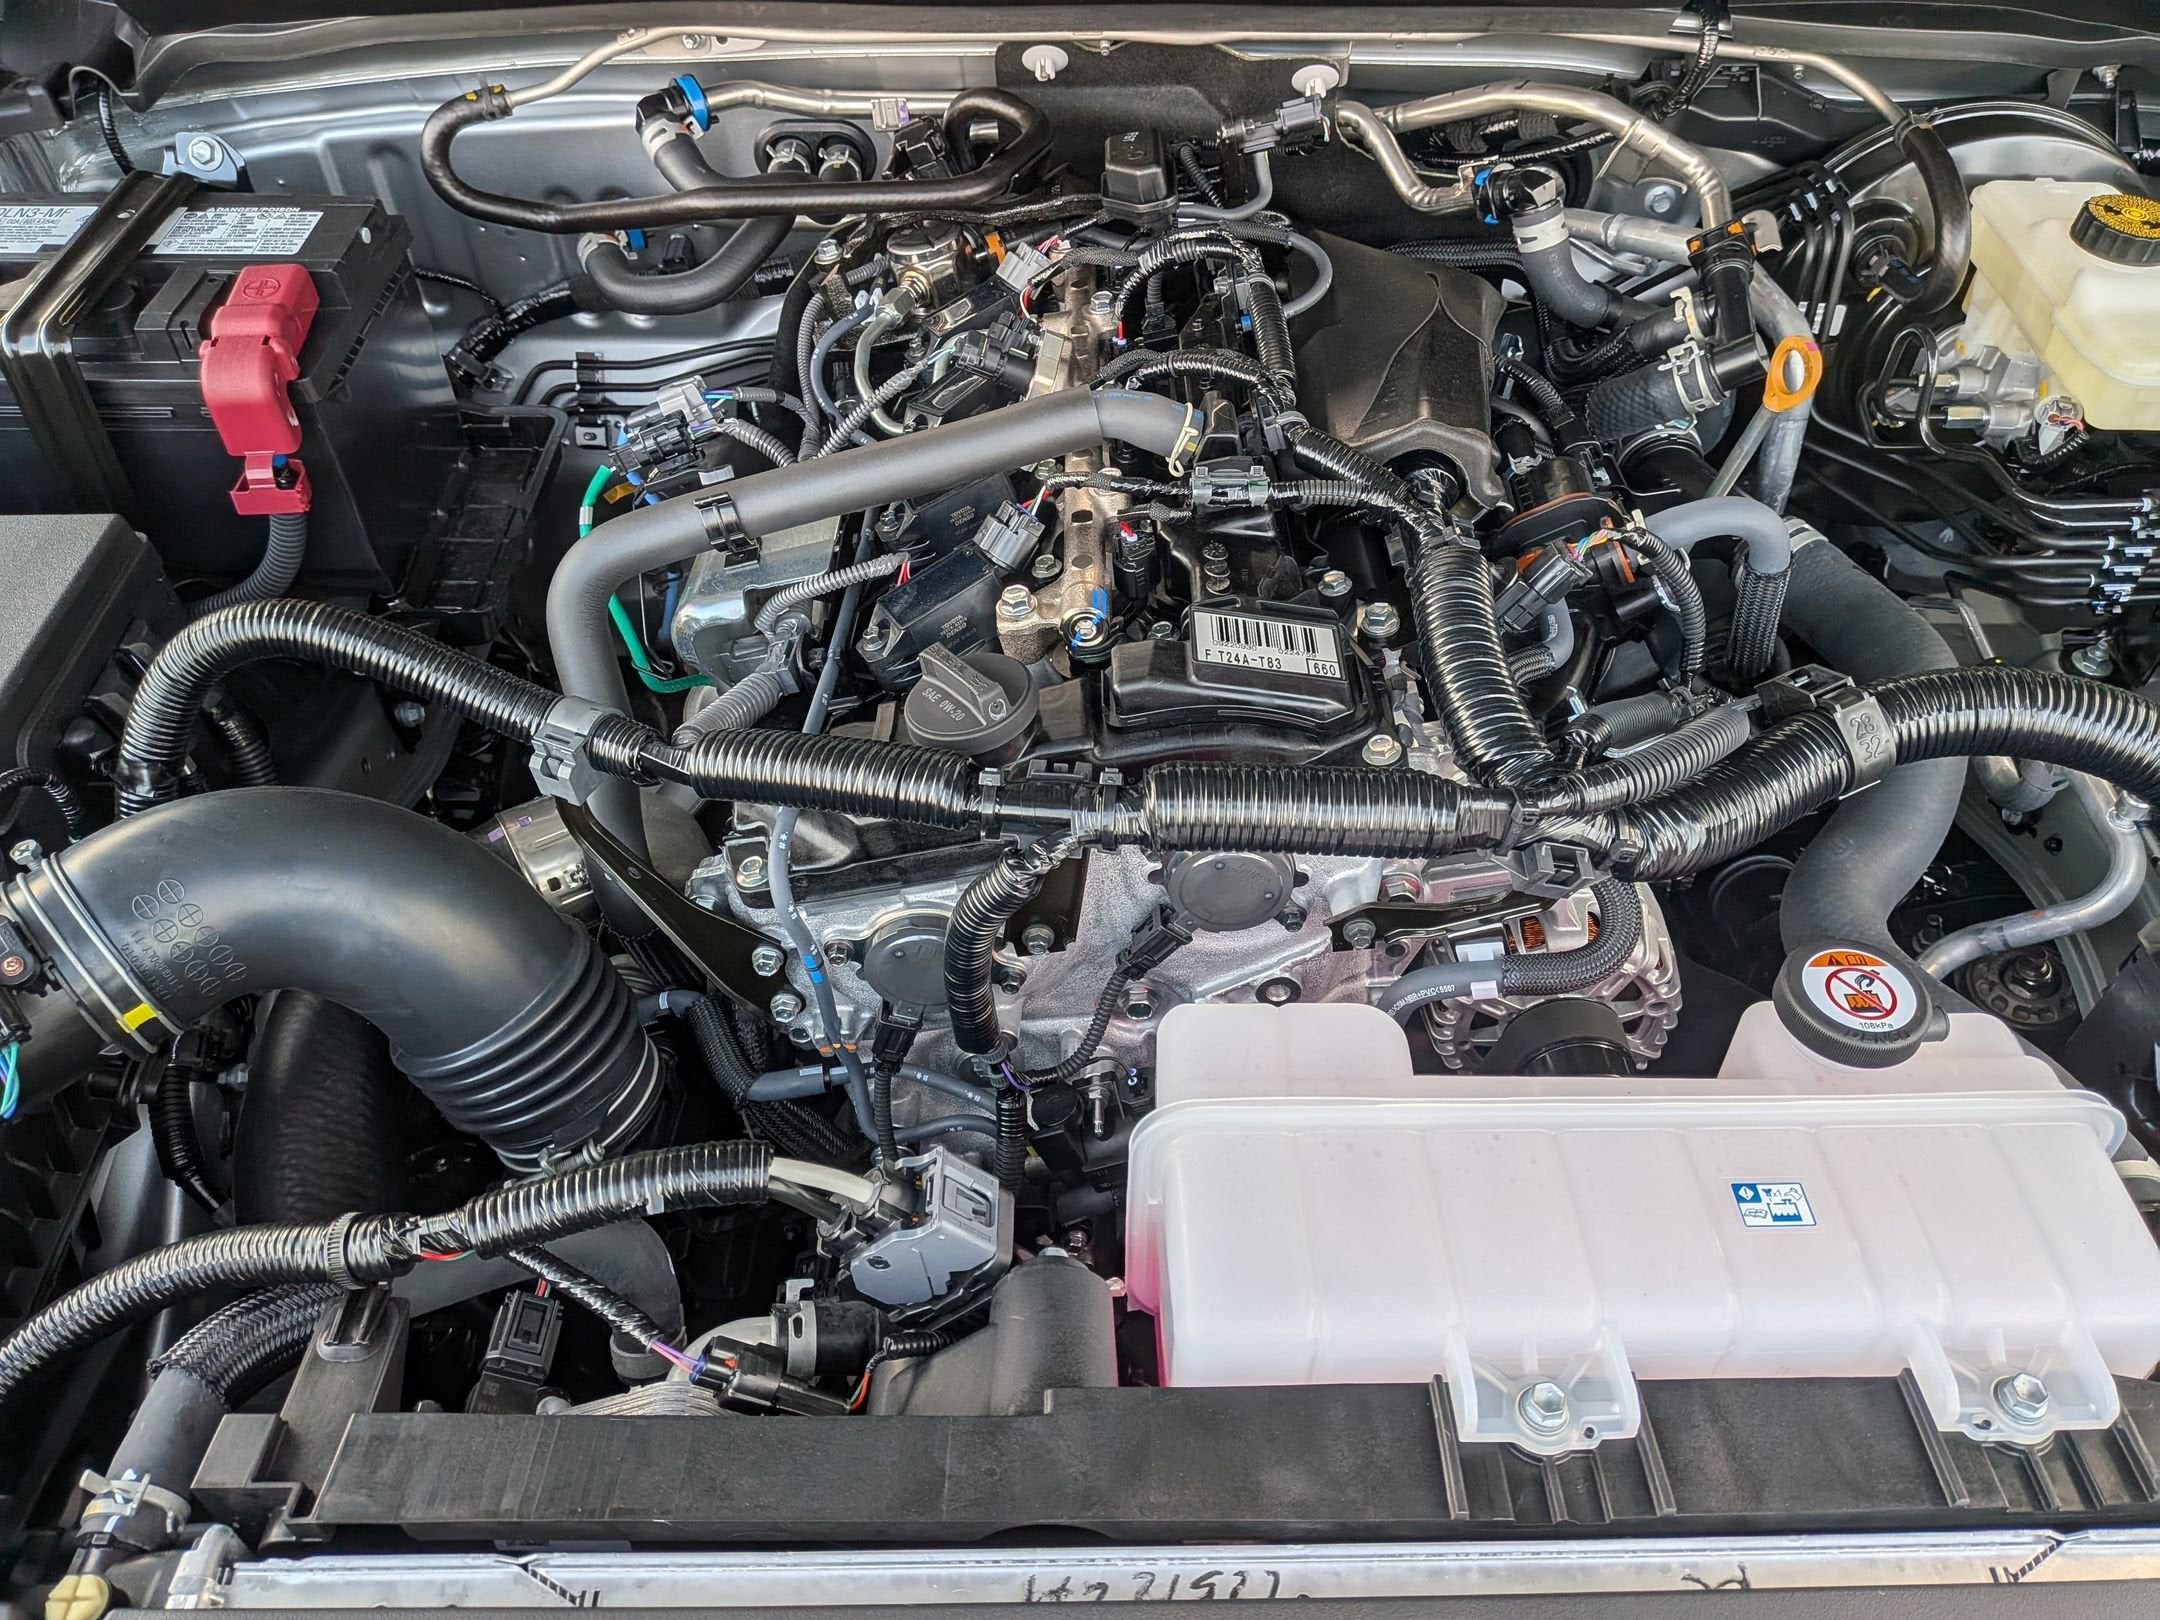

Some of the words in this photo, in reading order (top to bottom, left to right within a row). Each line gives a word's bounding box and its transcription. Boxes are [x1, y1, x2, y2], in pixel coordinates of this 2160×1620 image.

[940, 614, 964, 629] TOYOTA
[946, 622, 967, 639] DENSO
[1204, 648, 1212, 660] F
[1217, 650, 1283, 670] T24A-T83
[1314, 662, 1337, 677] 660
[921, 687, 943, 703] SAE
[938, 700, 967, 722] 0W-20
[1849, 712, 1875, 740] 28
[1859, 734, 1886, 763] 32
[1858, 1022, 1895, 1030] 108kPa
